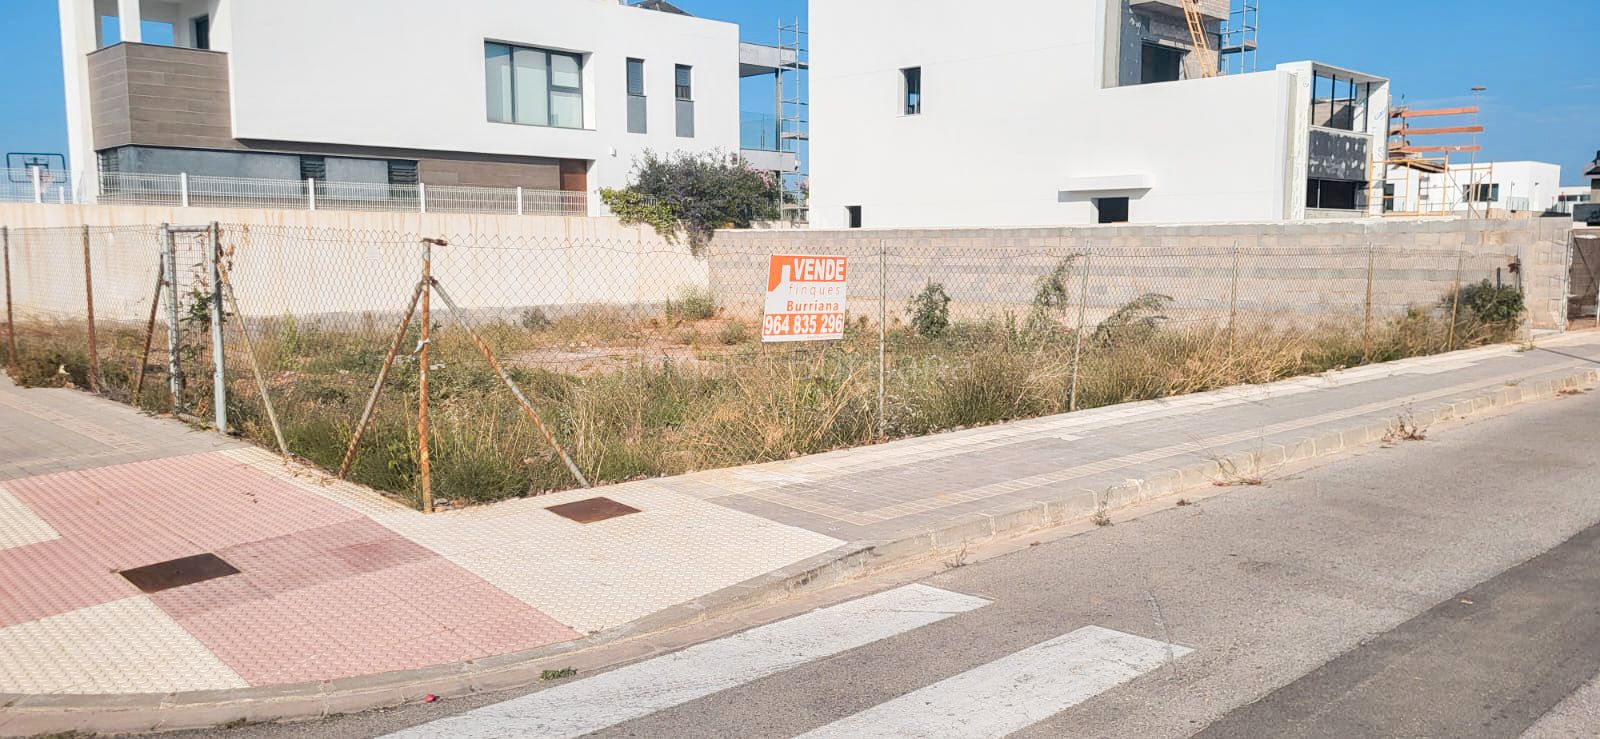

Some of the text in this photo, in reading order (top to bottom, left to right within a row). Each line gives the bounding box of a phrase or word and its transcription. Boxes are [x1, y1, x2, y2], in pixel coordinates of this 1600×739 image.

[793, 257, 845, 281] VENDE
[788, 283, 841, 298] finques
[786, 300, 839, 312] Burriana
[764, 314, 843, 335] 964 835 296
